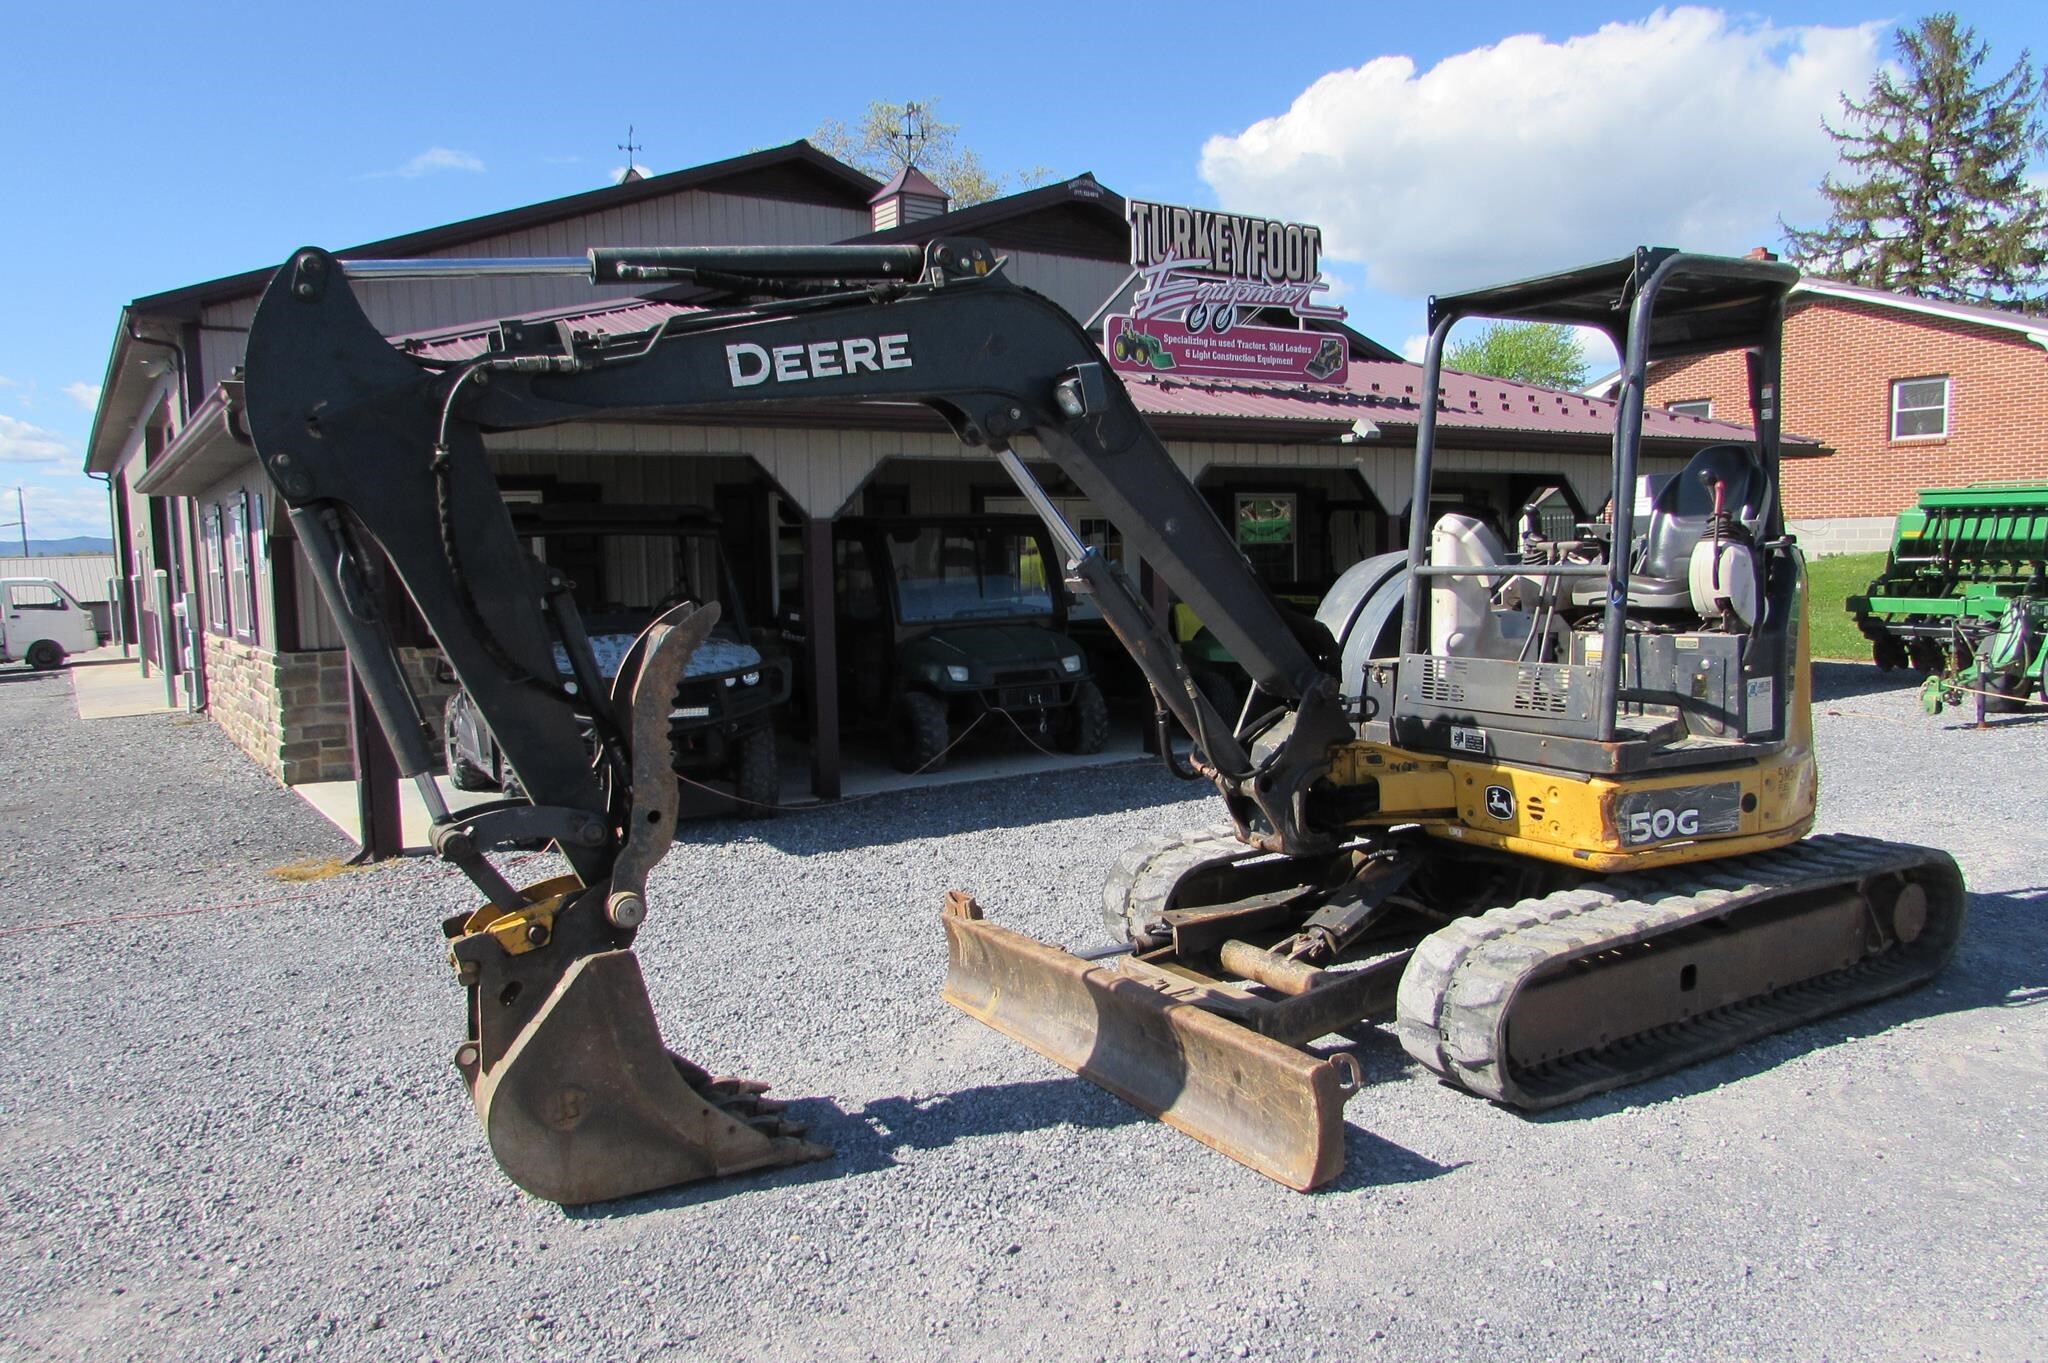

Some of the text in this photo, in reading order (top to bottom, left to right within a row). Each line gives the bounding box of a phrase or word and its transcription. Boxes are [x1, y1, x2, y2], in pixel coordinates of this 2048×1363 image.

[1133, 203, 1318, 284] TURKEYFOOT
[1138, 251, 1344, 329] Equipment
[725, 333, 912, 388] DEERE
[1163, 333, 1208, 348] Specializing
[1209, 337, 1217, 347] in
[1218, 338, 1236, 349] used
[1269, 342, 1284, 352] Skid
[1285, 343, 1312, 354] Loaders
[1185, 348, 1294, 366] & Light Construction Equipment
[1630, 808, 1699, 843] 50G
